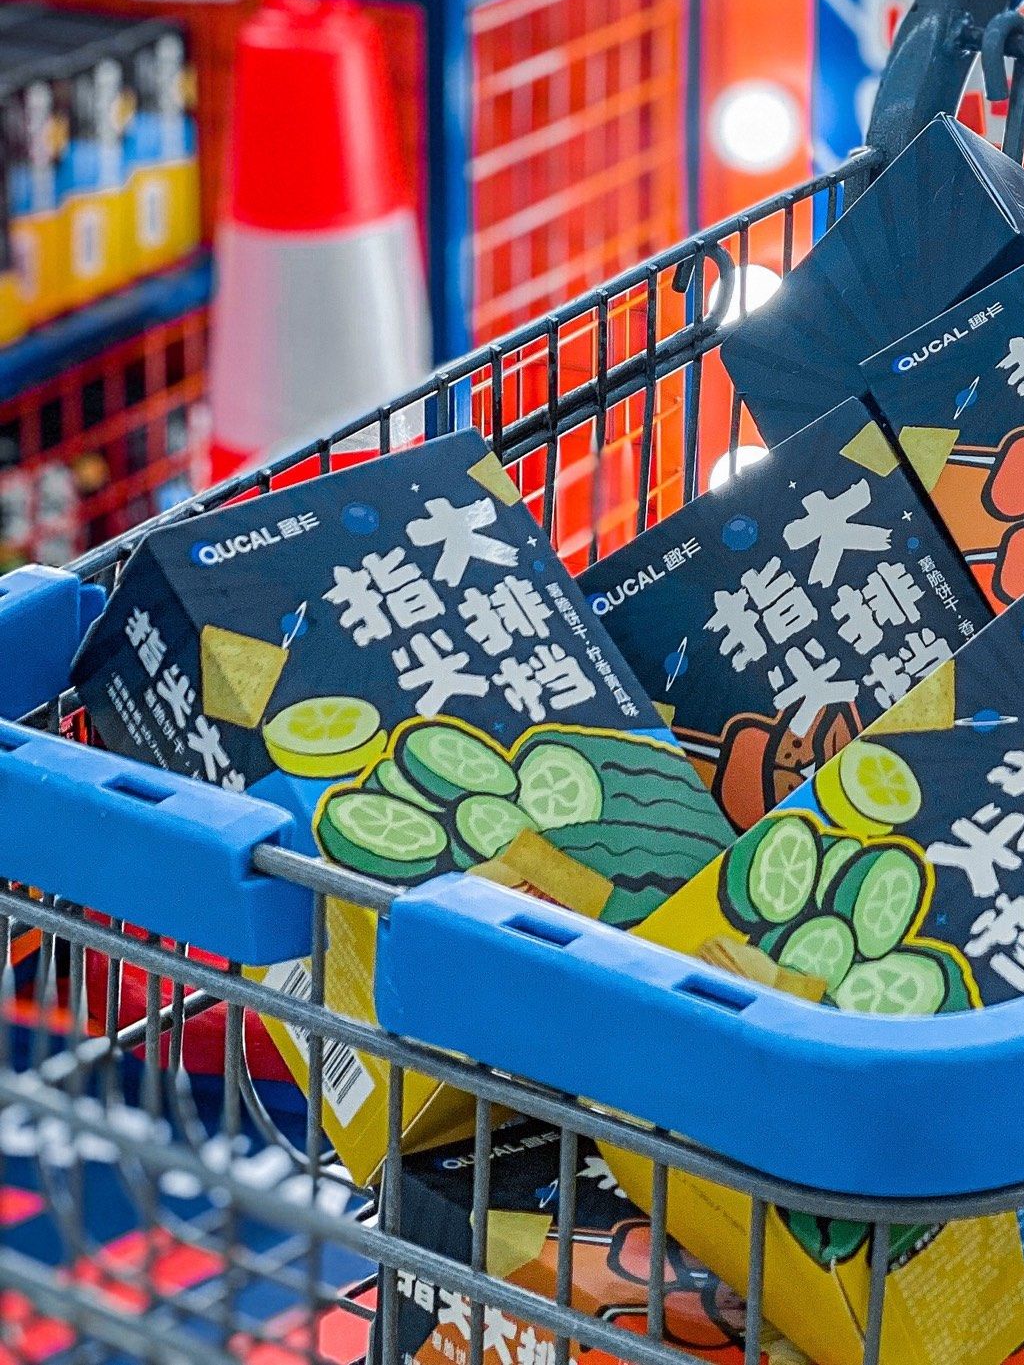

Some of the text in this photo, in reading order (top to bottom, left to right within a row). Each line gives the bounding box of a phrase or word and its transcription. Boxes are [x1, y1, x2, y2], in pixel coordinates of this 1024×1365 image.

[897, 302, 1004, 371] QUCAL 趣卡
[198, 526, 281, 566] QUCAL
[591, 536, 703, 617] QUCAL 趣卡
